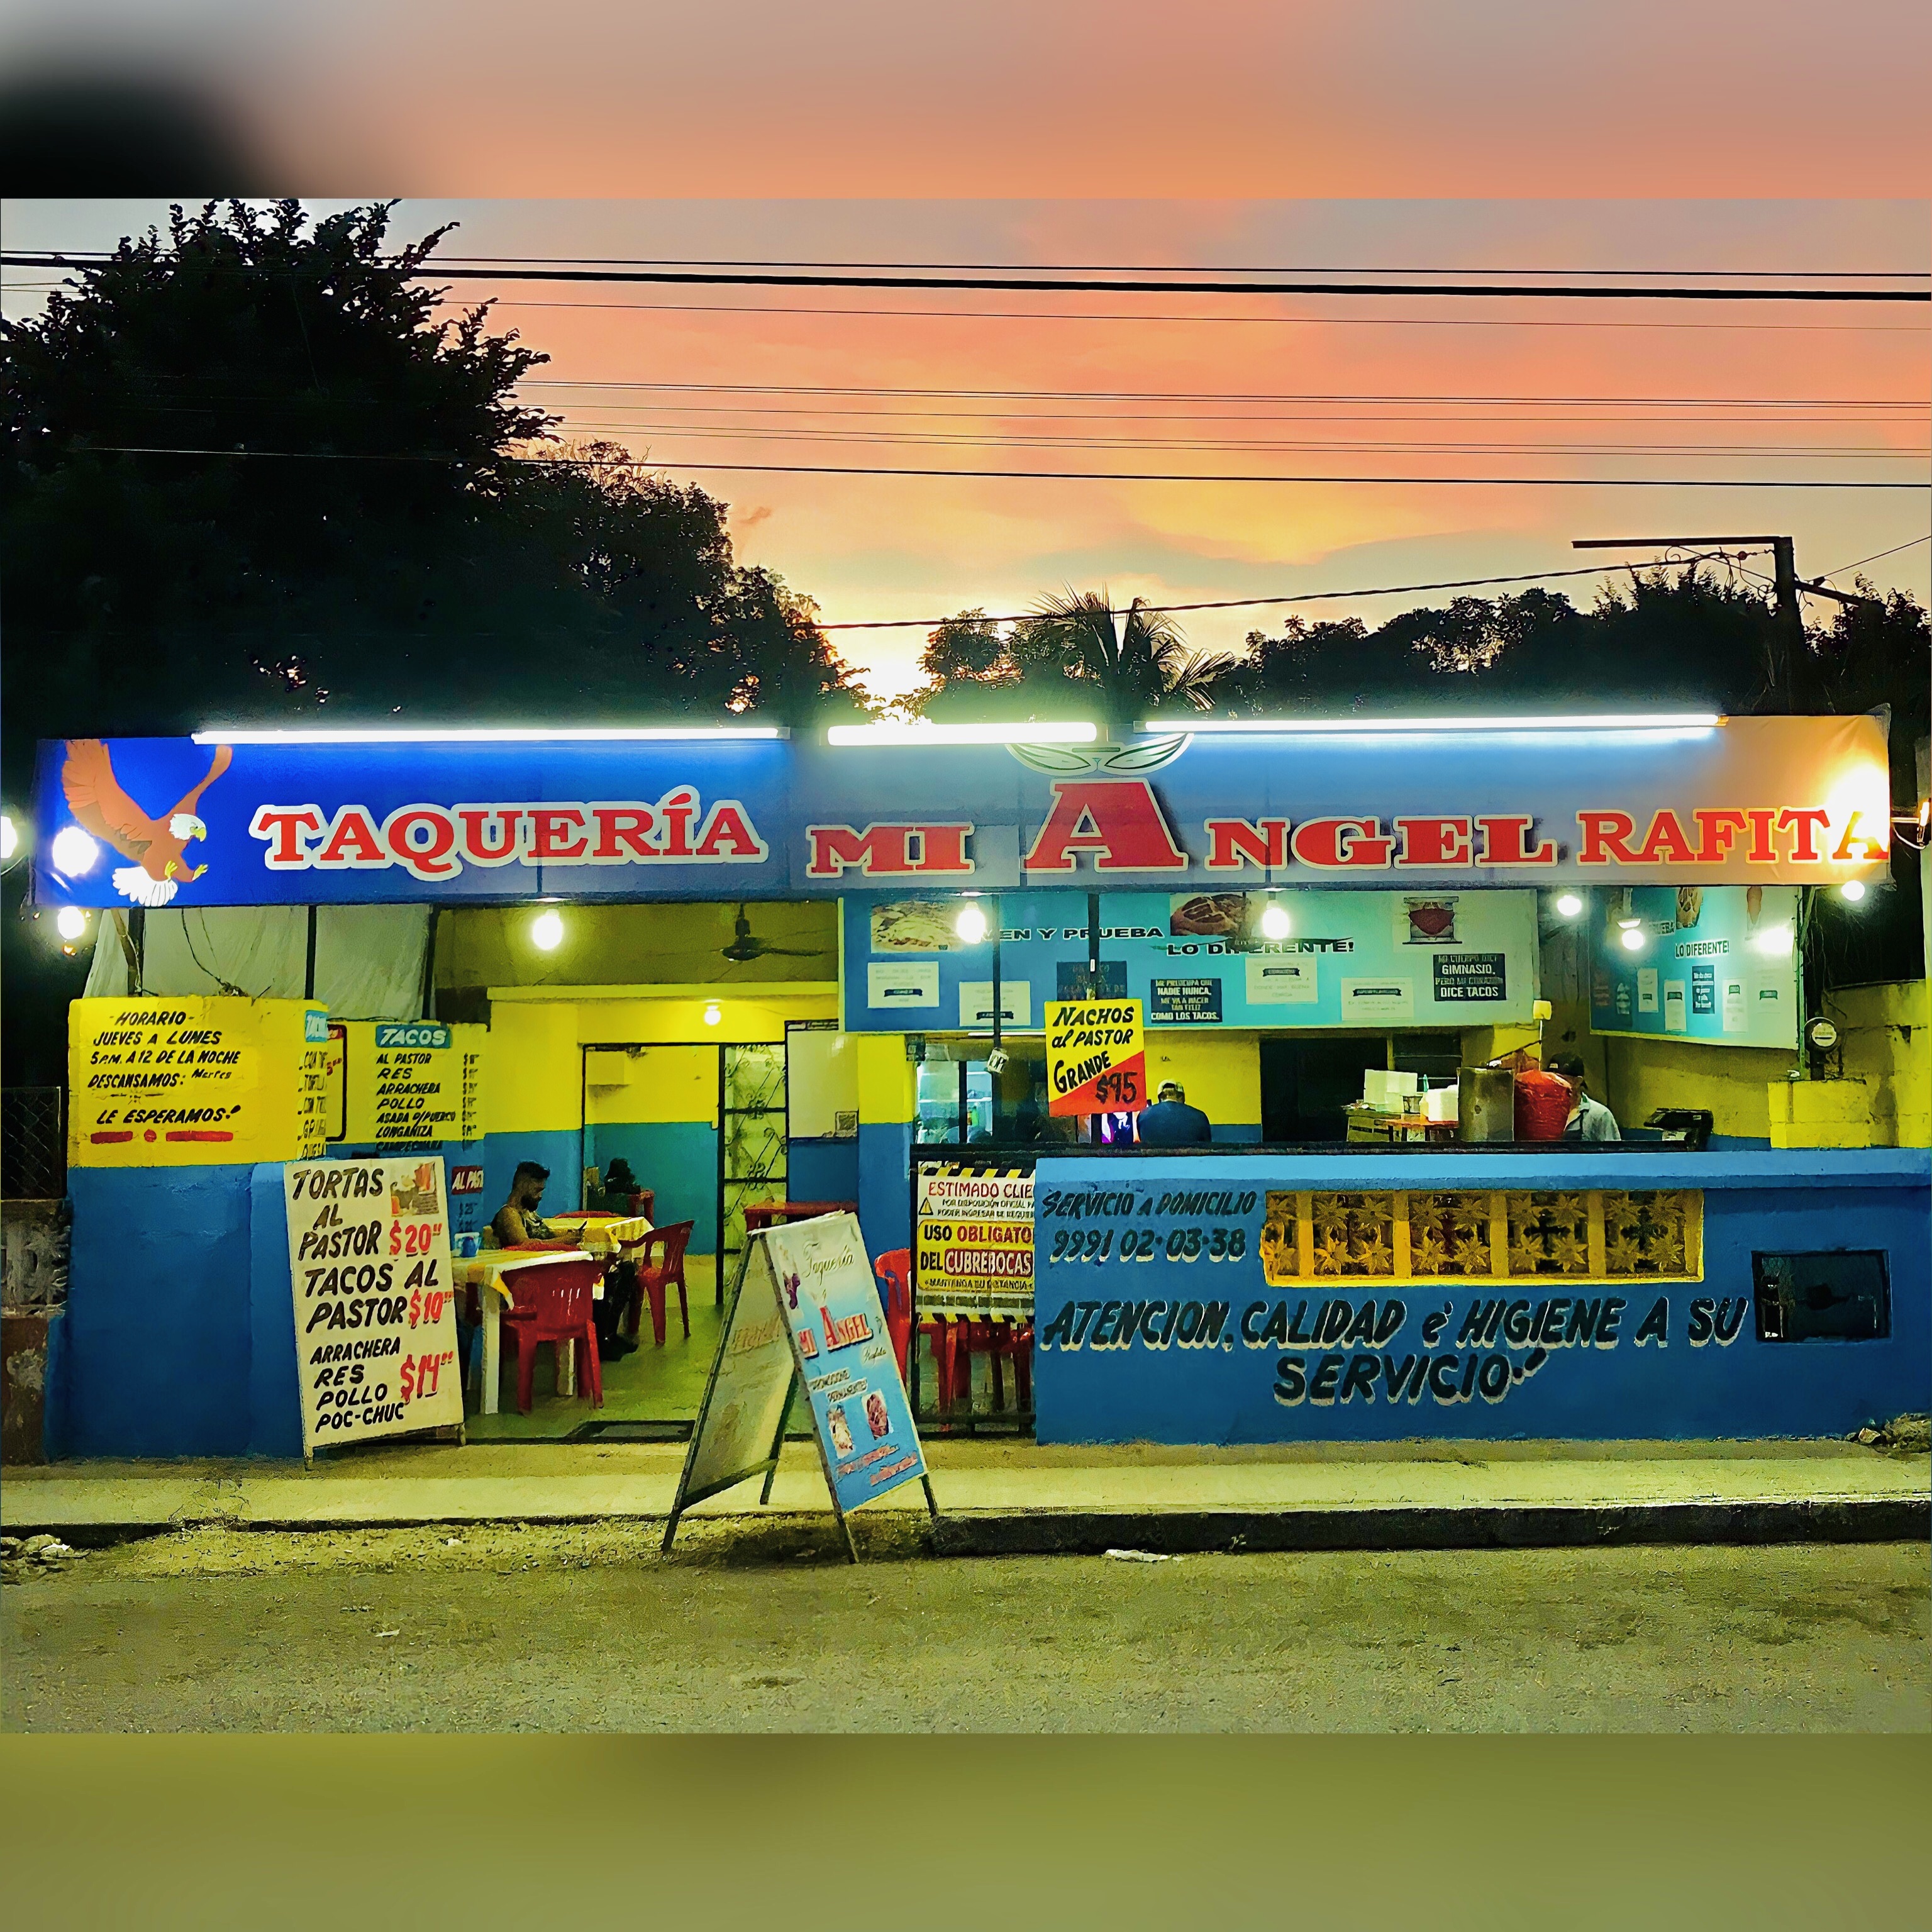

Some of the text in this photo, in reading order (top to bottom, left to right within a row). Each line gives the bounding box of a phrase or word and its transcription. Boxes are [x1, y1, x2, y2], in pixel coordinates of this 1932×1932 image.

[255, 788, 764, 878] TAQUERÍA
[809, 825, 971, 874] MI
[1579, 809, 1889, 865] RAFITA
[1038, 928, 1057, 940] Y
[1167, 943, 1199, 955] LO
[1675, 943, 1684, 957] LO
[1440, 987, 1498, 997] DICE TACOS
[1052, 1006, 1135, 1026] NACHOS
[1151, 1012, 1174, 1020] COMO
[1175, 1012, 1191, 1020] LOS
[93, 1030, 222, 1046] JUEVES A LUNES
[380, 1028, 447, 1045] TACOS
[1052, 1029, 1133, 1048] al PASTOR
[126, 1051, 135, 1063] A
[138, 1050, 153, 1063] 12
[156, 1050, 175, 1063] DE
[177, 1050, 195, 1064] LA
[197, 1051, 241, 1064] NOCHE
[376, 1053, 432, 1064] AL PASTOR
[87, 1072, 186, 1089] DESCANSAMOS:
[377, 1067, 413, 1079] RES
[1053, 1051, 1111, 1094] GRANDE
[375, 1082, 441, 1096] ARRACHERA
[1095, 1072, 1137, 1104] $95
[376, 1097, 425, 1109] POLLO
[96, 1109, 118, 1124] LE
[375, 1113, 409, 1123] ASADA
[375, 1124, 433, 1138] LONGANIZA
[292, 1167, 384, 1200] TORTAS
[452, 1171, 465, 1190] AL
[928, 1182, 999, 1197] ESTIMADO
[1043, 1191, 1258, 1219] SERVICIO A DOMICILIO
[313, 1203, 343, 1231] AL
[297, 1219, 382, 1262] PASTOR
[924, 1224, 1034, 1243] USO OBLIGATO
[920, 1250, 1032, 1275] DEL CUBREBOCAS
[304, 1258, 439, 1297] TACOS AL
[306, 1296, 408, 1334] PASTOR
[1240, 1299, 1407, 1350] CALIDAD
[1456, 1297, 1627, 1350] HIGIENE
[1634, 1296, 1669, 1348] A
[1688, 1296, 1749, 1348] SU
[310, 1336, 401, 1365] ARRACHERA
[313, 1363, 365, 1389] RES
[316, 1382, 387, 1411] POLLO
[314, 1402, 404, 1433] POC-CHUC
